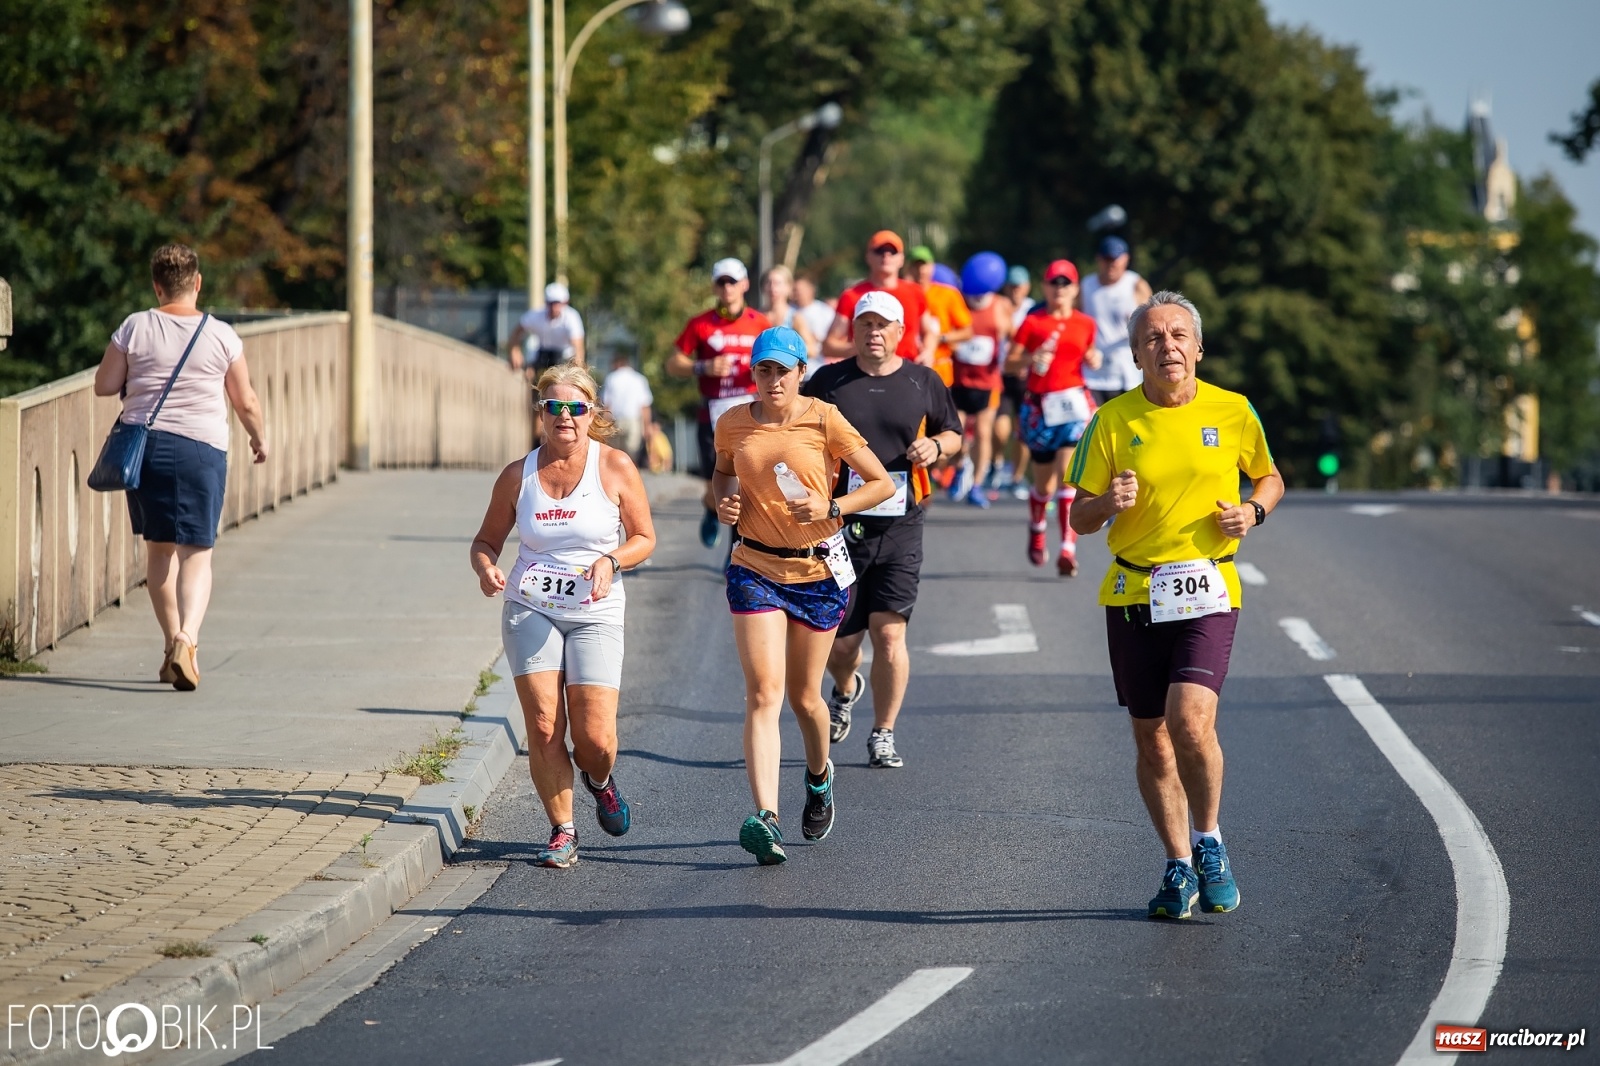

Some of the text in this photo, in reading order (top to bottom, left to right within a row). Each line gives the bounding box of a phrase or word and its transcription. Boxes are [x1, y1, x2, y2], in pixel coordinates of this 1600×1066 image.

[535, 509, 577, 521] RAFAKO
[541, 576, 576, 596] 312
[1173, 575, 1210, 597] 304
